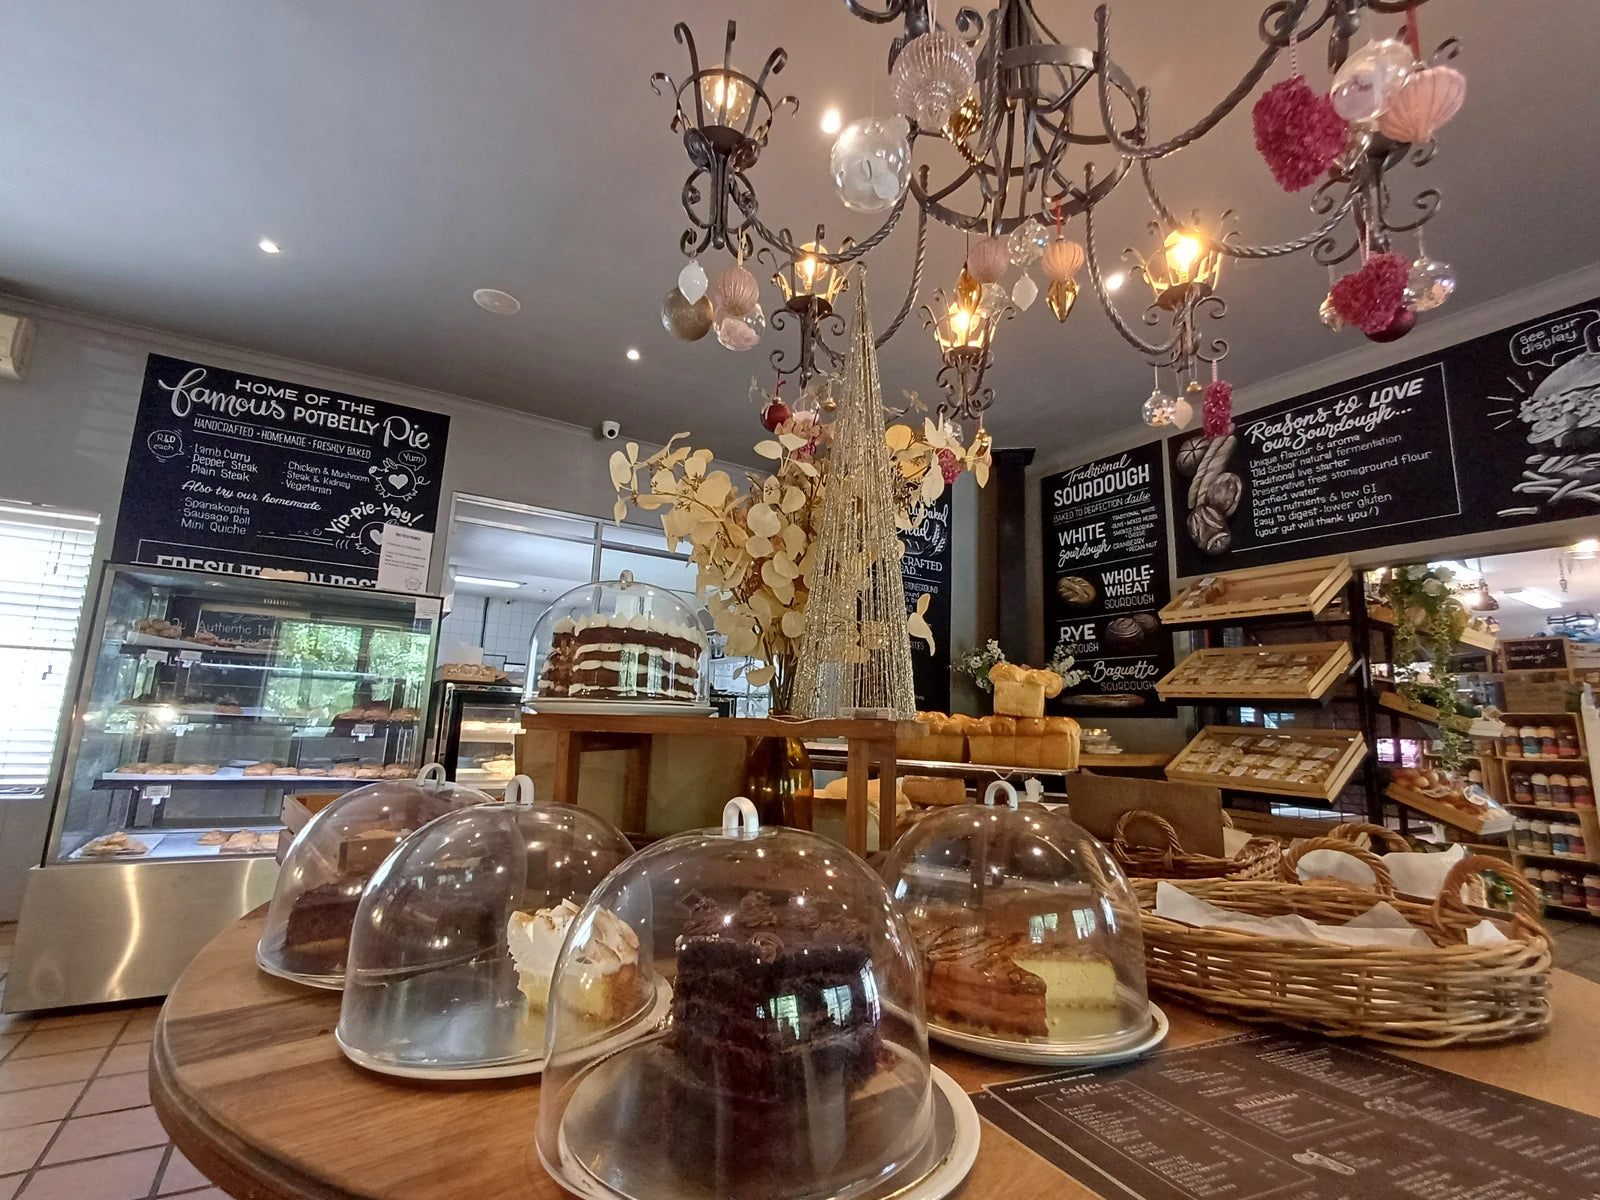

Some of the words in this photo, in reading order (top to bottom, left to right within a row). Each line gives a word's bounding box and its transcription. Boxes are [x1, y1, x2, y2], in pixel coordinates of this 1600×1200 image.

[1520, 331, 1545, 345] See
[1550, 318, 1581, 333] our
[1521, 330, 1576, 355] display
[158, 367, 285, 420] famous
[294, 406, 380, 436] POTBELLY
[383, 415, 431, 449] Pie
[235, 379, 299, 401] HOME
[305, 393, 331, 406] OF
[337, 399, 376, 416] THE
[1244, 408, 1332, 444] Reasons
[1333, 395, 1362, 417] to
[1368, 378, 1425, 408] LOVE
[153, 443, 174, 451] each
[194, 418, 254, 437] HANDCRAFTED
[261, 430, 307, 447] HOMEMADE
[312, 440, 345, 457] FRESHLY
[346, 446, 371, 460] BAKED
[1262, 437, 1293, 453] our
[1299, 451, 1332, 465] natural
[1336, 434, 1402, 457] fermentation
[192, 453, 225, 468] Pepper
[231, 460, 258, 473] Steak
[194, 442, 221, 457] Lamb
[223, 449, 251, 463] Curry
[1249, 456, 1278, 469] Unique
[1280, 447, 1313, 460] flavour
[1316, 442, 1324, 451] &
[1326, 434, 1360, 449] aroma
[191, 463, 216, 476] Plain
[220, 468, 250, 482] Steak
[286, 470, 311, 482] Steak
[312, 475, 320, 483] &
[323, 479, 351, 490] Kidney
[288, 461, 321, 474] Chicken
[323, 467, 330, 475] &
[331, 469, 370, 483] Mushroom
[1062, 454, 1131, 486] Traditional
[1251, 470, 1295, 487] Traditional
[1297, 468, 1312, 477] live
[1315, 459, 1350, 473] starter
[1252, 480, 1305, 497] Preservative
[1308, 475, 1327, 485] free
[1331, 456, 1399, 480] stoneground
[1401, 451, 1433, 464] flour
[181, 480, 212, 494] Also
[215, 485, 233, 499] try
[236, 491, 258, 502] our
[261, 493, 322, 511] homemade
[285, 479, 332, 495] Vegetarian
[1054, 463, 1150, 507] SOURDOUGH
[185, 497, 250, 516] Spanakopita
[1053, 511, 1074, 523] BAKED
[1075, 508, 1084, 518] TO
[1084, 498, 1123, 515] PERFECTION
[1124, 490, 1151, 505] daily
[1252, 493, 1288, 507] Purified
[1290, 487, 1320, 499] water
[1283, 496, 1326, 511] nutrients
[1329, 492, 1337, 501] &
[1341, 489, 1360, 500] low
[1362, 483, 1377, 494] GI
[183, 507, 229, 523] Sausage
[232, 514, 250, 525] Roll
[1253, 517, 1275, 528] Easy
[1277, 513, 1286, 522] to
[1356, 493, 1393, 508] gluten
[1255, 526, 1279, 538] (your
[1281, 523, 1296, 534] gut
[1297, 518, 1314, 529] will
[1316, 513, 1344, 526] thank
[1347, 506, 1379, 523] you!)
[181, 518, 204, 530] Mini
[209, 521, 247, 535] Quiche
[1059, 522, 1106, 546] WHITE
[1146, 540, 1158, 549] NUT
[1101, 564, 1155, 585] WHOLE-
[1105, 580, 1150, 597] WHEAT
[1104, 594, 1155, 609] SOURDOUGH
[1060, 623, 1096, 642] RYE
[1090, 660, 1160, 683] Baguette
[1101, 680, 1155, 691] SOURDOUGH
